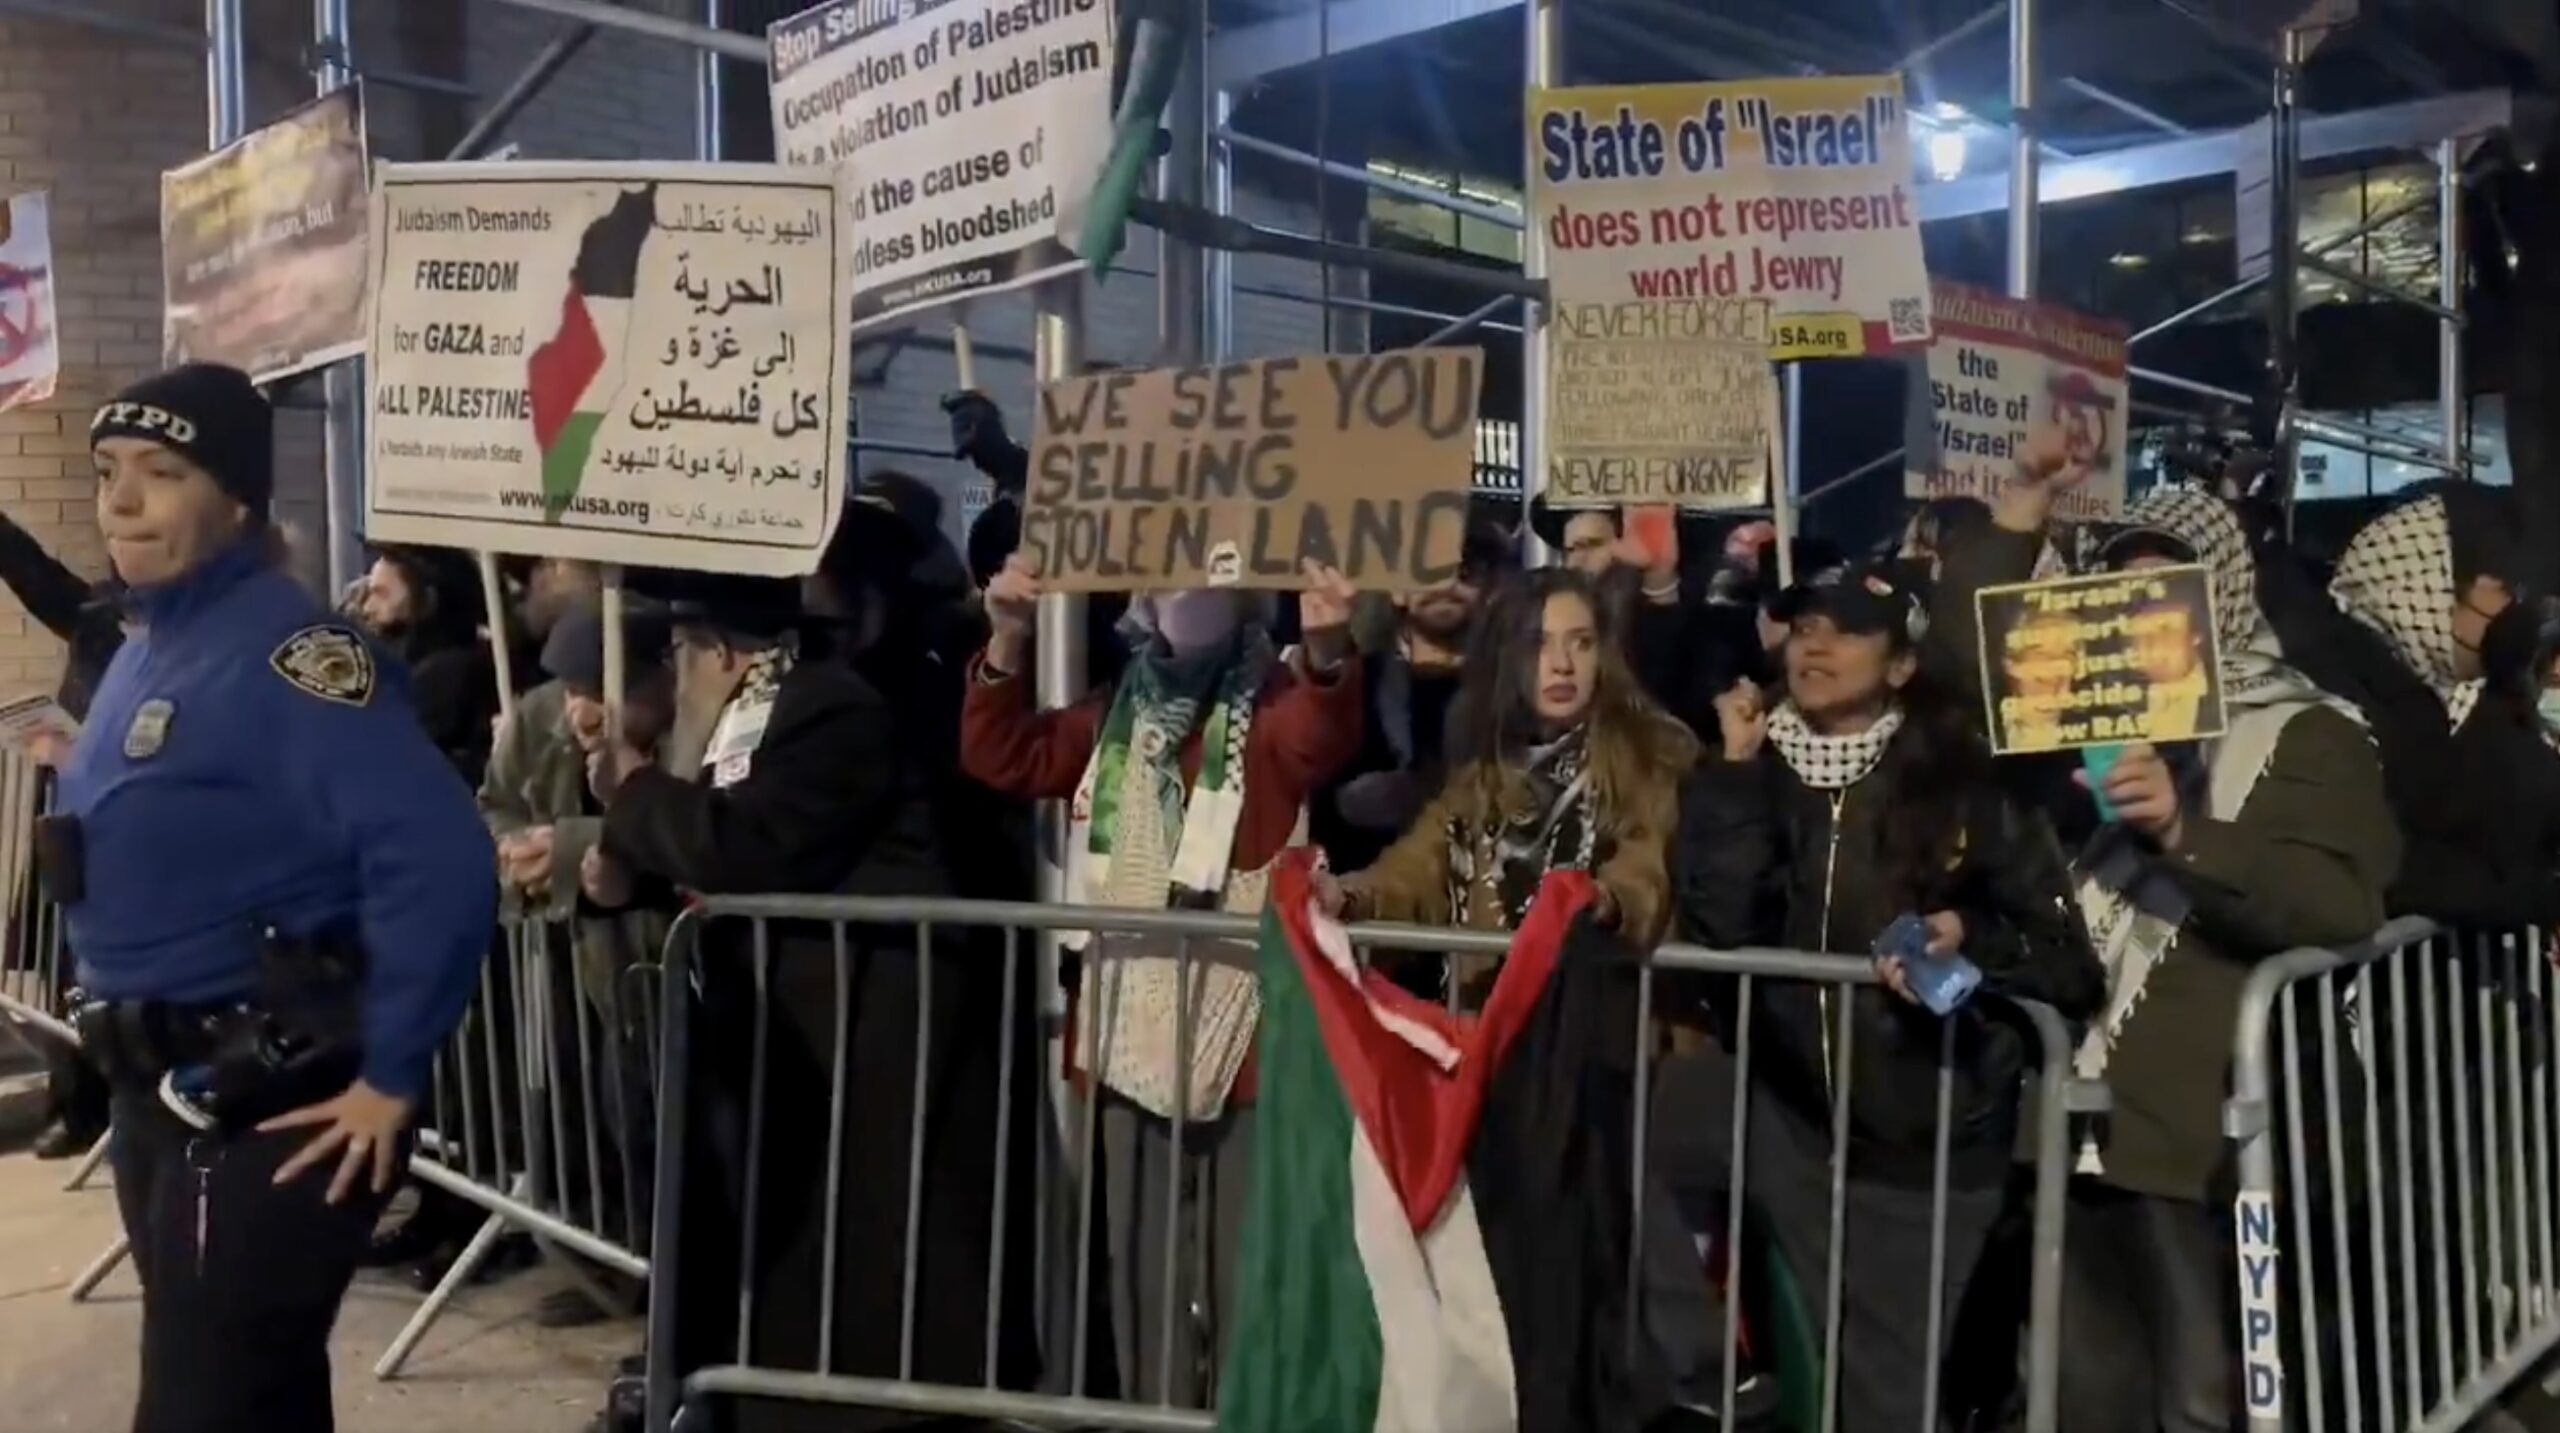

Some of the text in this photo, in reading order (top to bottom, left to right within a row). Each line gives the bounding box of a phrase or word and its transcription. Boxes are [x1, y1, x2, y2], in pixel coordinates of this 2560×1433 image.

[784, 53, 907, 130] Occupation
[914, 27, 939, 71] of
[830, 98, 928, 159] violation
[936, 75, 962, 118] of
[973, 41, 1100, 108] Judaism
[1541, 96, 1896, 184] State of "Israel"
[871, 178, 915, 215] the
[922, 150, 1011, 197] cause
[1019, 126, 1044, 170] of
[396, 206, 552, 233] Judaism Demands
[732, 204, 822, 245] اليهودية
[921, 184, 1056, 254] bloodshed
[1550, 183, 1910, 250] does not represent
[415, 260, 519, 292] FREEDOM
[673, 250, 783, 317] الحرية
[1628, 246, 1844, 301] world Jewry
[394, 323, 525, 356] for GAZA and
[1558, 298, 1773, 344] NEVER FORGET
[659, 336, 680, 367] و
[688, 325, 741, 370] غزة
[1958, 347, 1999, 380] the
[377, 384, 533, 421] ALL PALESTINE
[629, 379, 820, 438] كل فلسطين
[1041, 356, 1473, 442] WE SEE YOU
[1930, 381, 2028, 423] State of
[490, 443, 524, 465] State
[600, 447, 660, 476] لليهود
[665, 443, 710, 480] دولة
[1931, 419, 2027, 461] "Israel"
[808, 467, 824, 490] و
[1549, 456, 1641, 497] NEVER
[1022, 504, 1213, 581] STOLEN
[2241, 1201, 2275, 1407] NYPD
